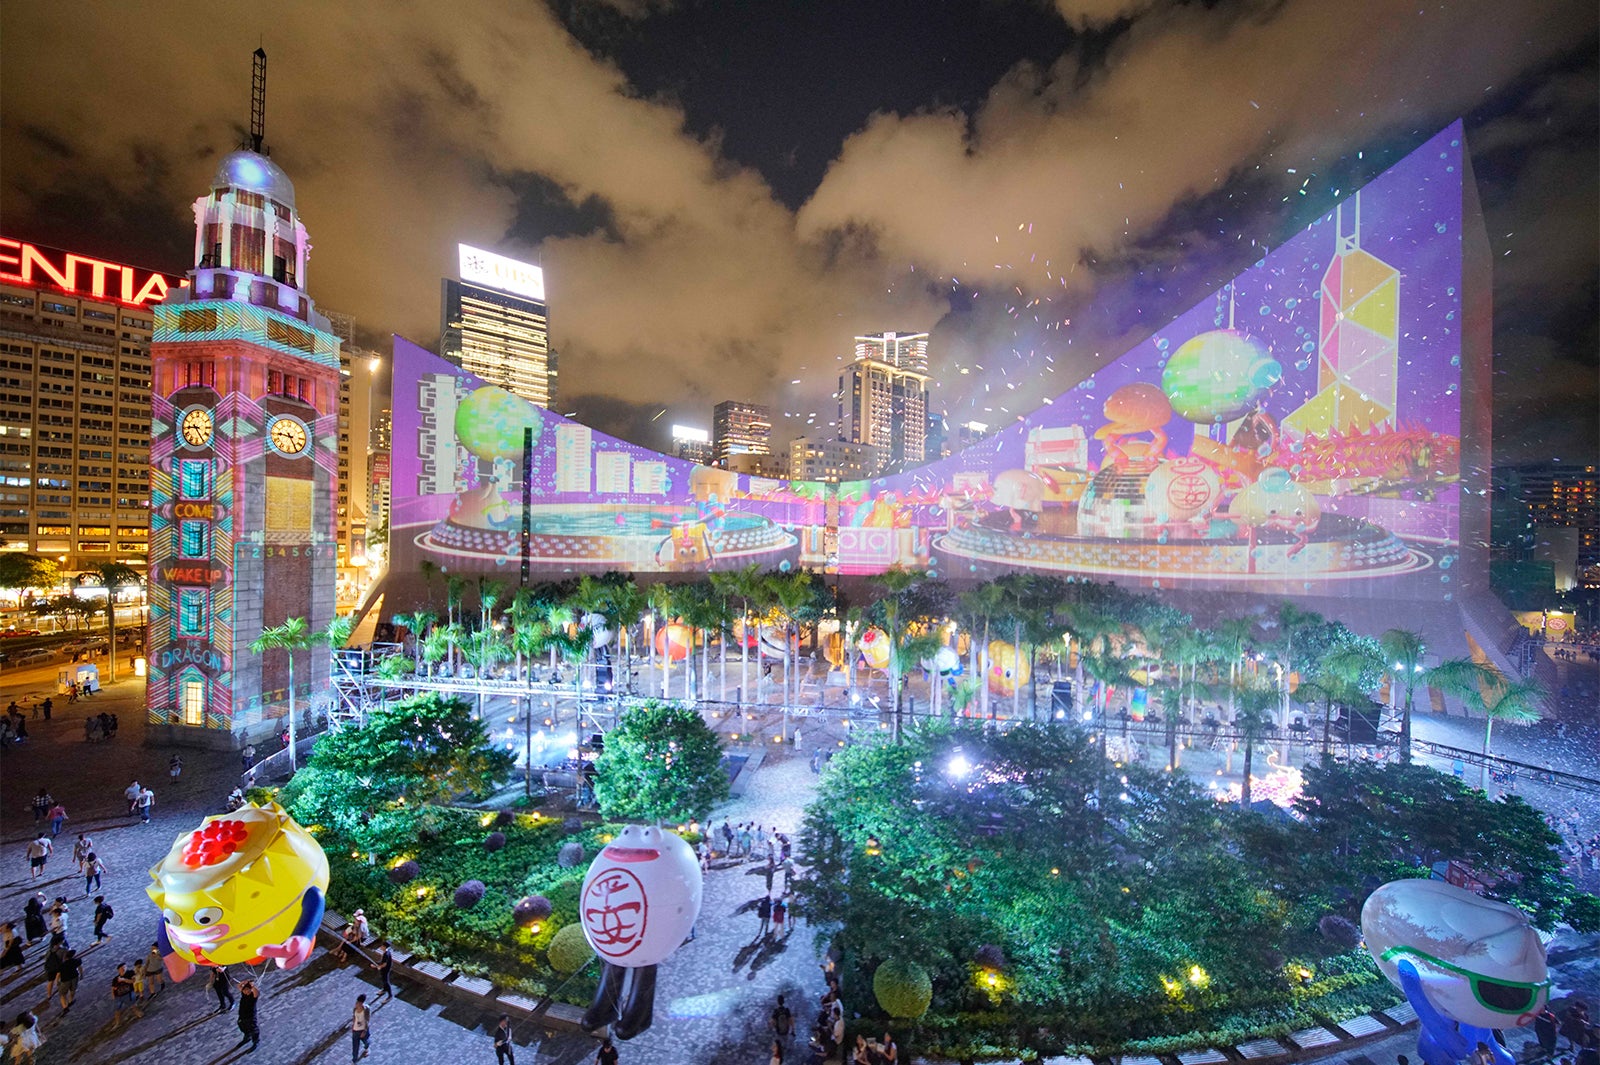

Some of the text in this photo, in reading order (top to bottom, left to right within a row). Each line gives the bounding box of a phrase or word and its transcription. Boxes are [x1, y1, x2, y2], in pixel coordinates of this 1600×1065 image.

[0, 237, 190, 305] ENTIA
[174, 503, 215, 519] COME
[252, 547, 260, 559] 2
[266, 547, 274, 558] 3
[278, 547, 286, 557] 4
[292, 547, 300, 557] 5
[304, 547, 312, 557] 6
[163, 567, 222, 583] WAKE UP
[187, 640, 201, 648] THE
[162, 647, 221, 672] DRAGON
